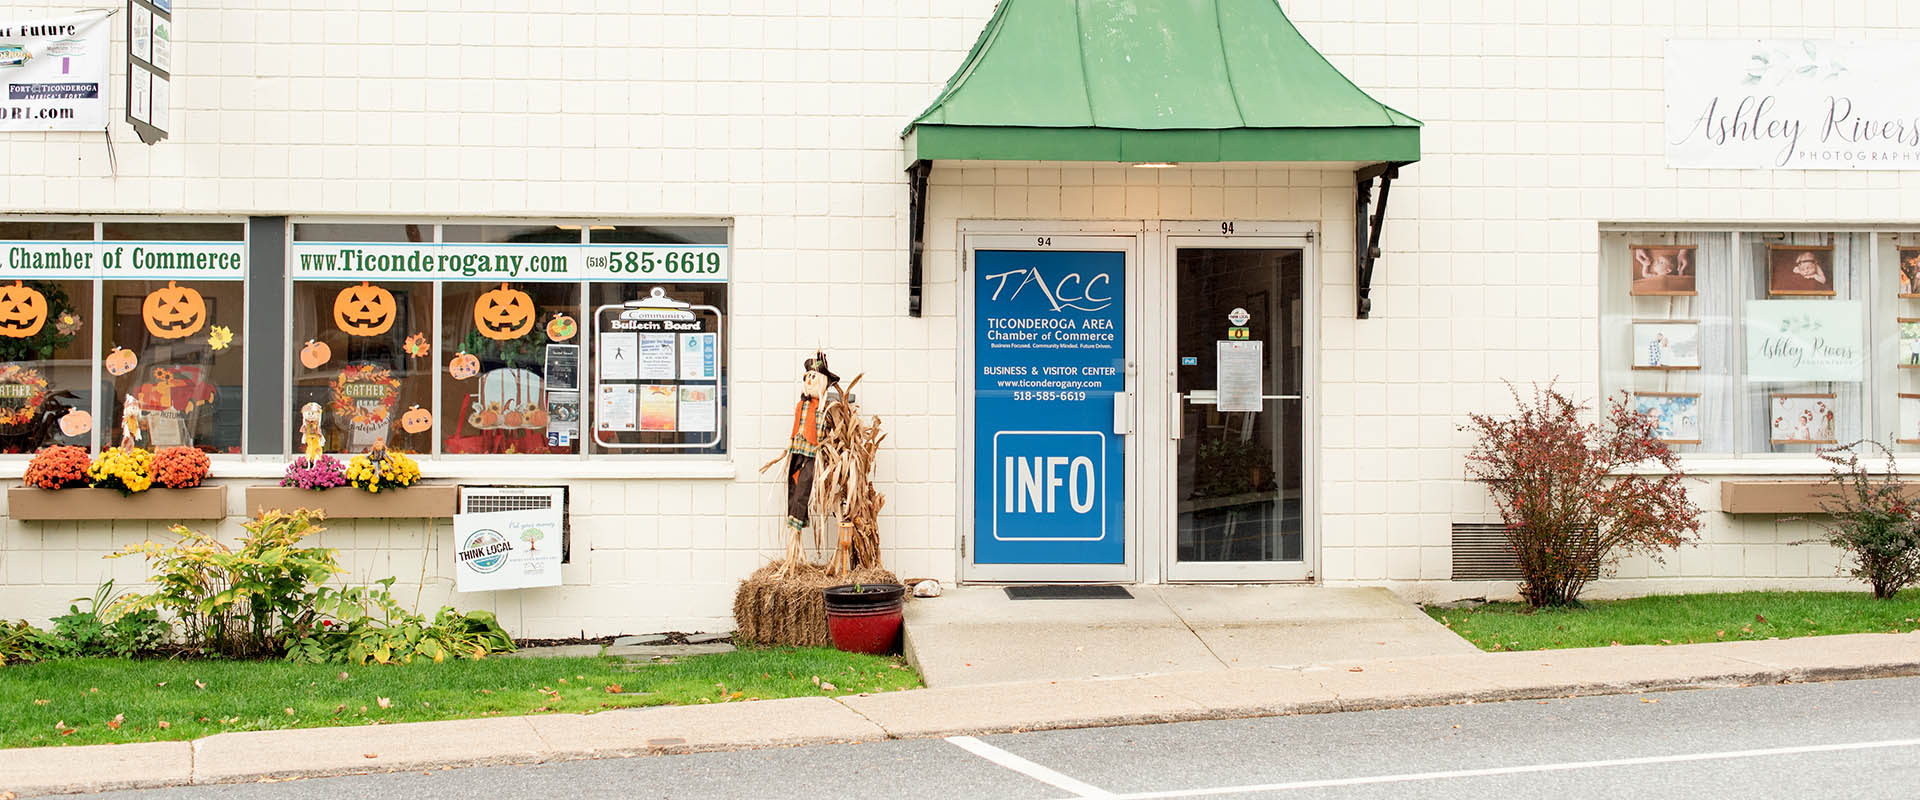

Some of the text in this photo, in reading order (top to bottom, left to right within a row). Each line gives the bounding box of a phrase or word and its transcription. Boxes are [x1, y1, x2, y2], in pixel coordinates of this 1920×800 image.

[21, 24, 76, 37] Future
[9, 84, 97, 93] FORT TICONDEROGA
[1670, 95, 1920, 167] Ashley Rivers
[1799, 151, 1920, 161] PHOTOGRAPHY
[1221, 221, 1235, 235] 94
[1037, 237, 1052, 247] 94
[9, 247, 241, 270] Chamber of Commerce
[300, 249, 568, 277] www.Ticonderogany.com
[586, 256, 608, 270] (518)
[985, 266, 1112, 312] TACC
[628, 311, 686, 320] Community
[611, 320, 702, 331] Bulletin Board
[987, 318, 1114, 330] TICONDEROGA AREA
[987, 330, 1115, 341] Chamber of Commerce
[1760, 335, 1853, 368] Ashley Rivers
[983, 366, 1116, 376] BUSINESS & VISITOR CENTER
[346, 384, 385, 396] GATHER
[997, 379, 1102, 390] www.ticonderogany.com
[1013, 391, 1086, 401] 518-585-6619
[1005, 456, 1095, 514] INFO
[458, 541, 514, 562] THINK LOCAL
